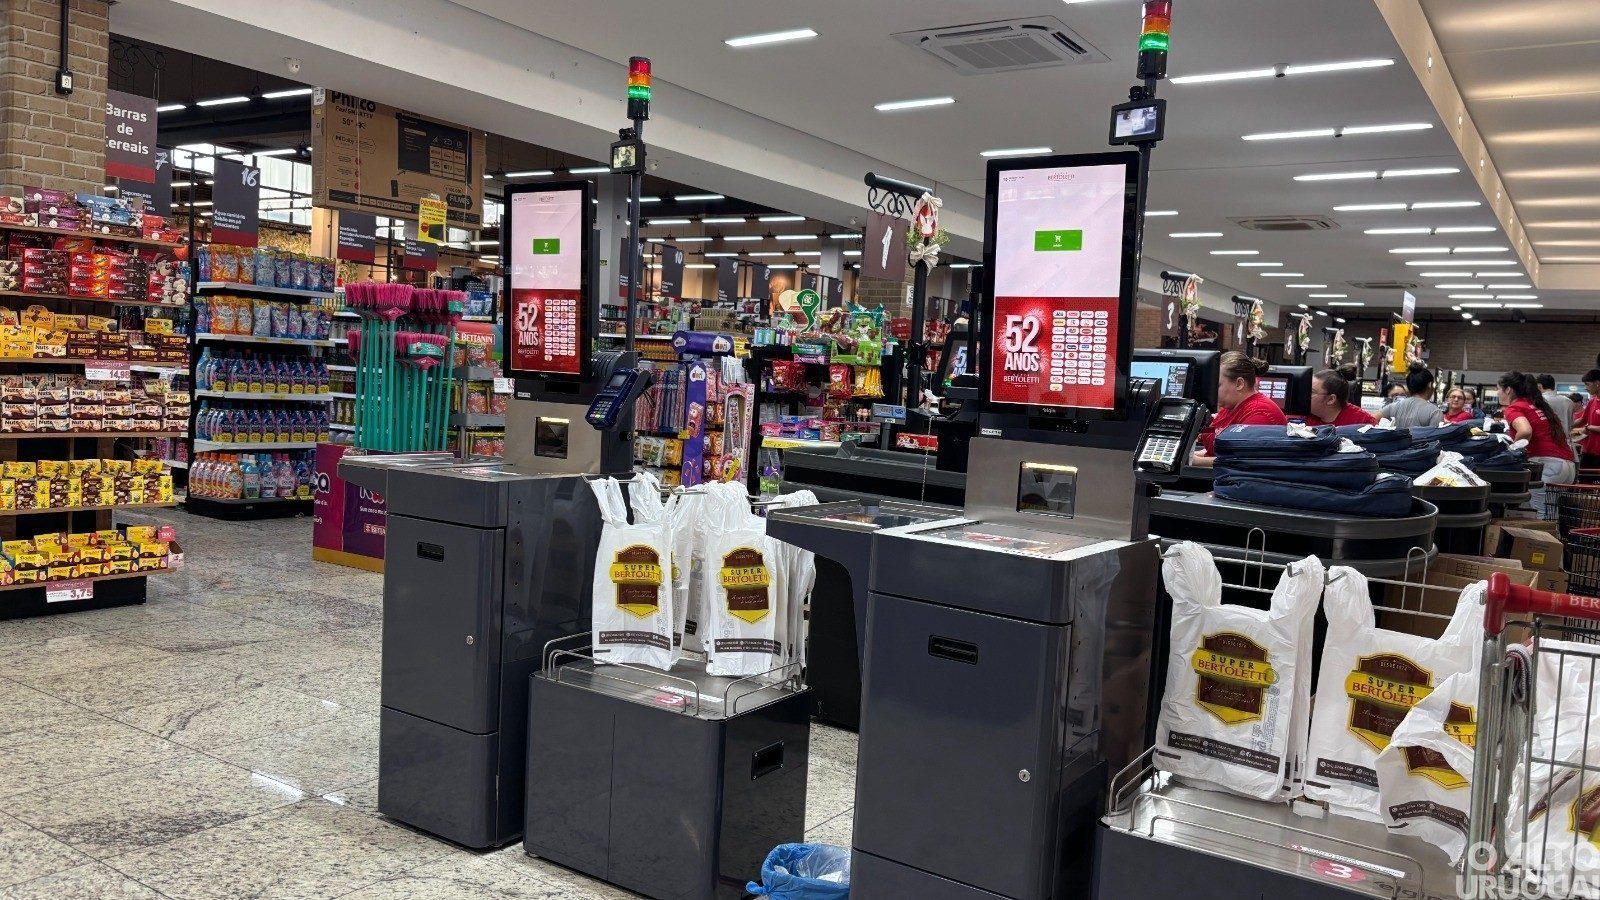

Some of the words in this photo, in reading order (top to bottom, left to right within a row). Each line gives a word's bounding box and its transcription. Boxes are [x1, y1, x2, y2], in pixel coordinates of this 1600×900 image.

[106, 102, 147, 122] Barras
[117, 122, 134, 136] de
[106, 136, 149, 155] ereais
[242, 167, 260, 187] 16
[882, 226, 893, 270] 1
[674, 250, 683, 265] 10
[732, 261, 738, 274] 9
[764, 268, 771, 280] 8
[811, 278, 816, 288] 7
[837, 281, 843, 293] 6
[24, 314, 51, 322] Prtein
[518, 302, 538, 332] 52
[1166, 302, 1174, 330] 3
[4, 327, 31, 335] Prtein
[518, 331, 539, 346] ANOS
[1004, 314, 1041, 353] 52
[461, 334, 493, 344] BETTANIN
[1286, 335, 1292, 355] 5
[1004, 352, 1040, 372] ANOS
[1003, 375, 1040, 384] BERTOLETTI
[731, 568, 762, 576] SUPER
[70, 588, 93, 600] 3,75
[1570, 594, 1600, 608] BER
[1211, 654, 1254, 669] SUPER
[1198, 659, 1267, 682] BERTOLETTI
[1368, 676, 1415, 694] SUPER
[1352, 682, 1424, 705] BERTOLET
[1325, 862, 1352, 879] 3
